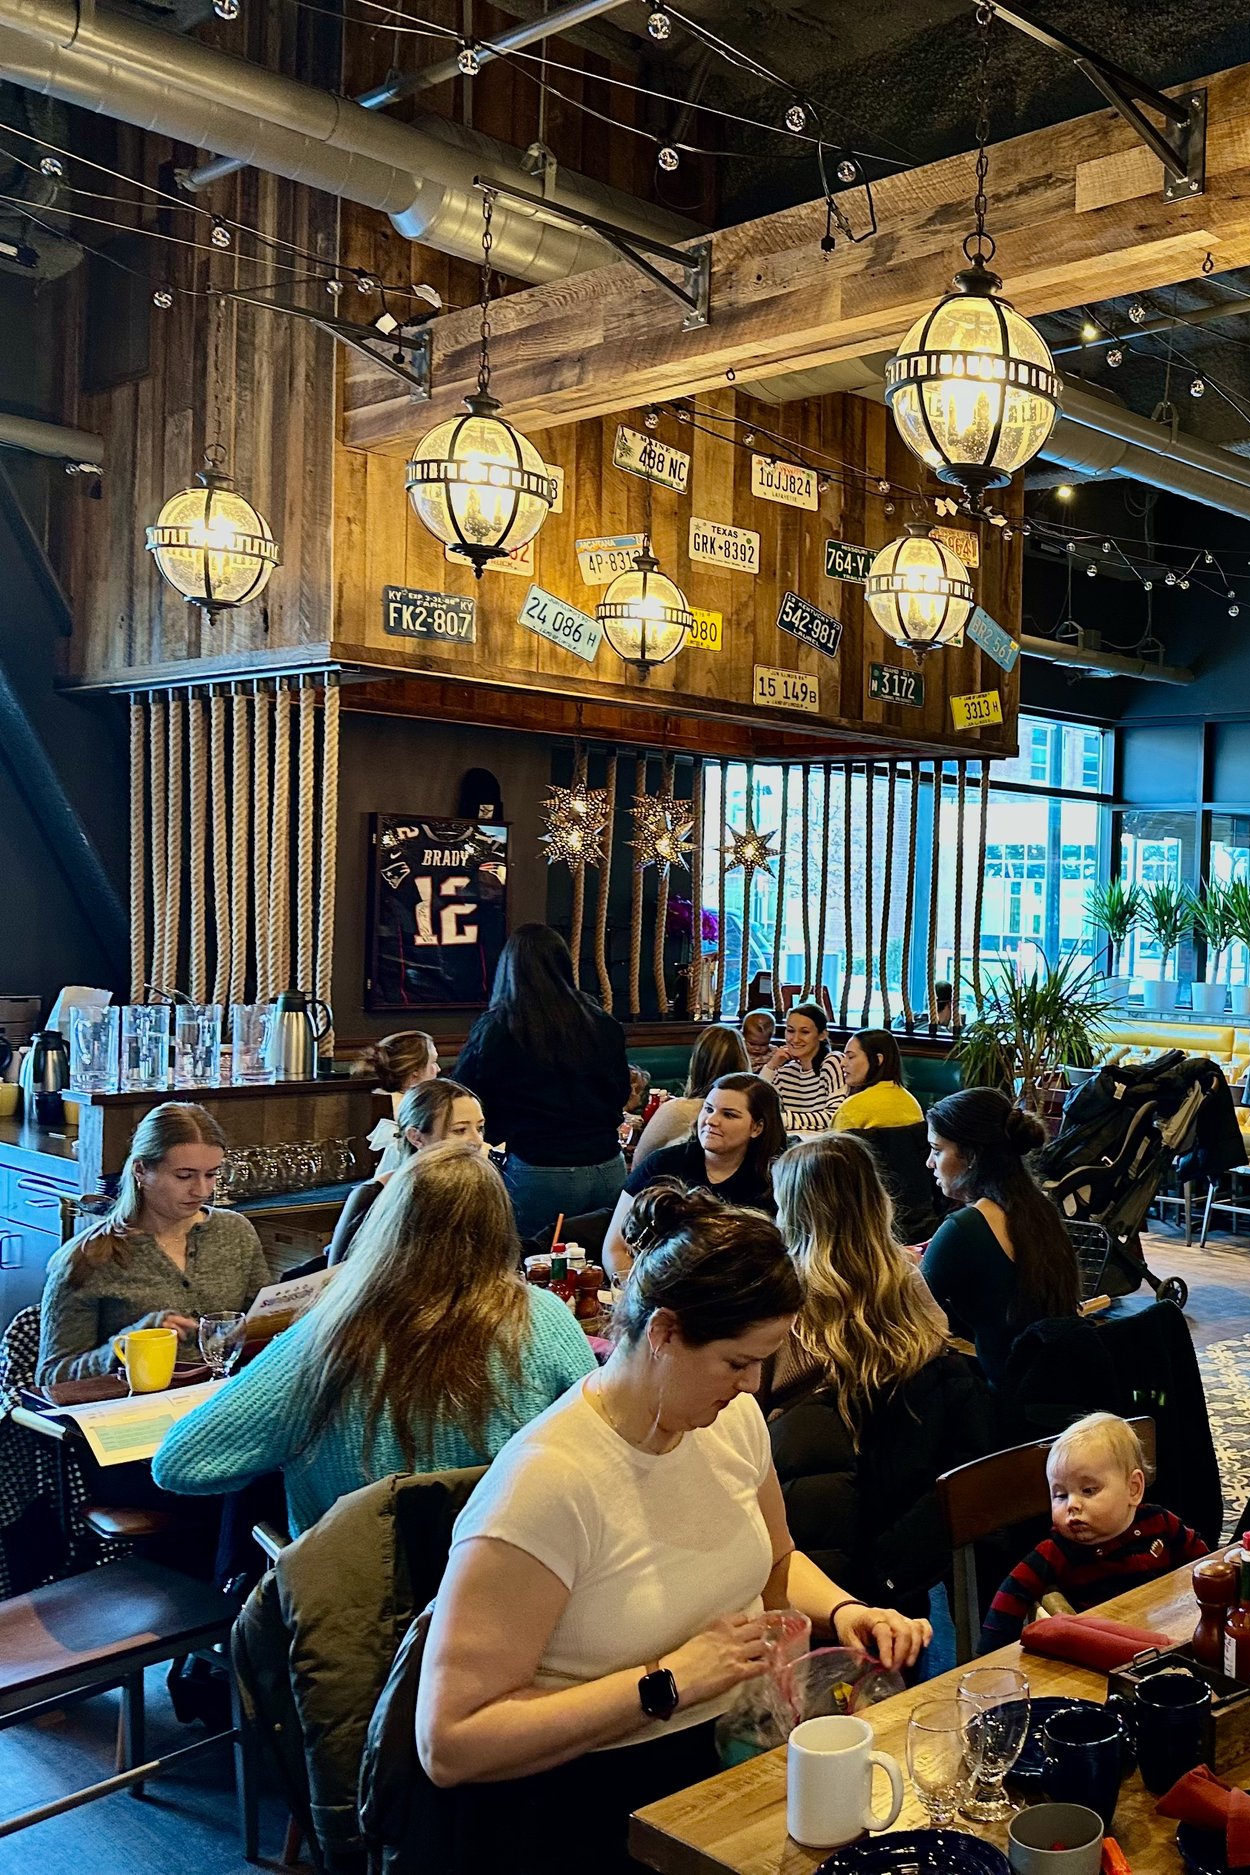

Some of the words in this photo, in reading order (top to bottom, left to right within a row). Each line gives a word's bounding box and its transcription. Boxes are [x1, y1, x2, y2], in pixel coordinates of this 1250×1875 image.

[668, 457, 686, 482] NC
[711, 525, 738, 538] TEXAS
[388, 590, 401, 601] KY
[460, 601, 474, 612] KY
[416, 600, 447, 610] FARM
[389, 603, 471, 637] FK2-807
[527, 597, 547, 624] 24
[552, 611, 584, 642] 086
[586, 632, 597, 647] H
[798, 602, 829, 623] KENTUCKY
[782, 601, 836, 649] 542-981
[793, 628, 820, 647] LAUREL
[759, 676, 776, 697] 15
[782, 680, 809, 702] 149
[809, 690, 817, 704] B
[964, 700, 990, 720] 3313
[993, 701, 999, 713] H
[421, 849, 470, 867] BRADY
[413, 875, 479, 946] 12
